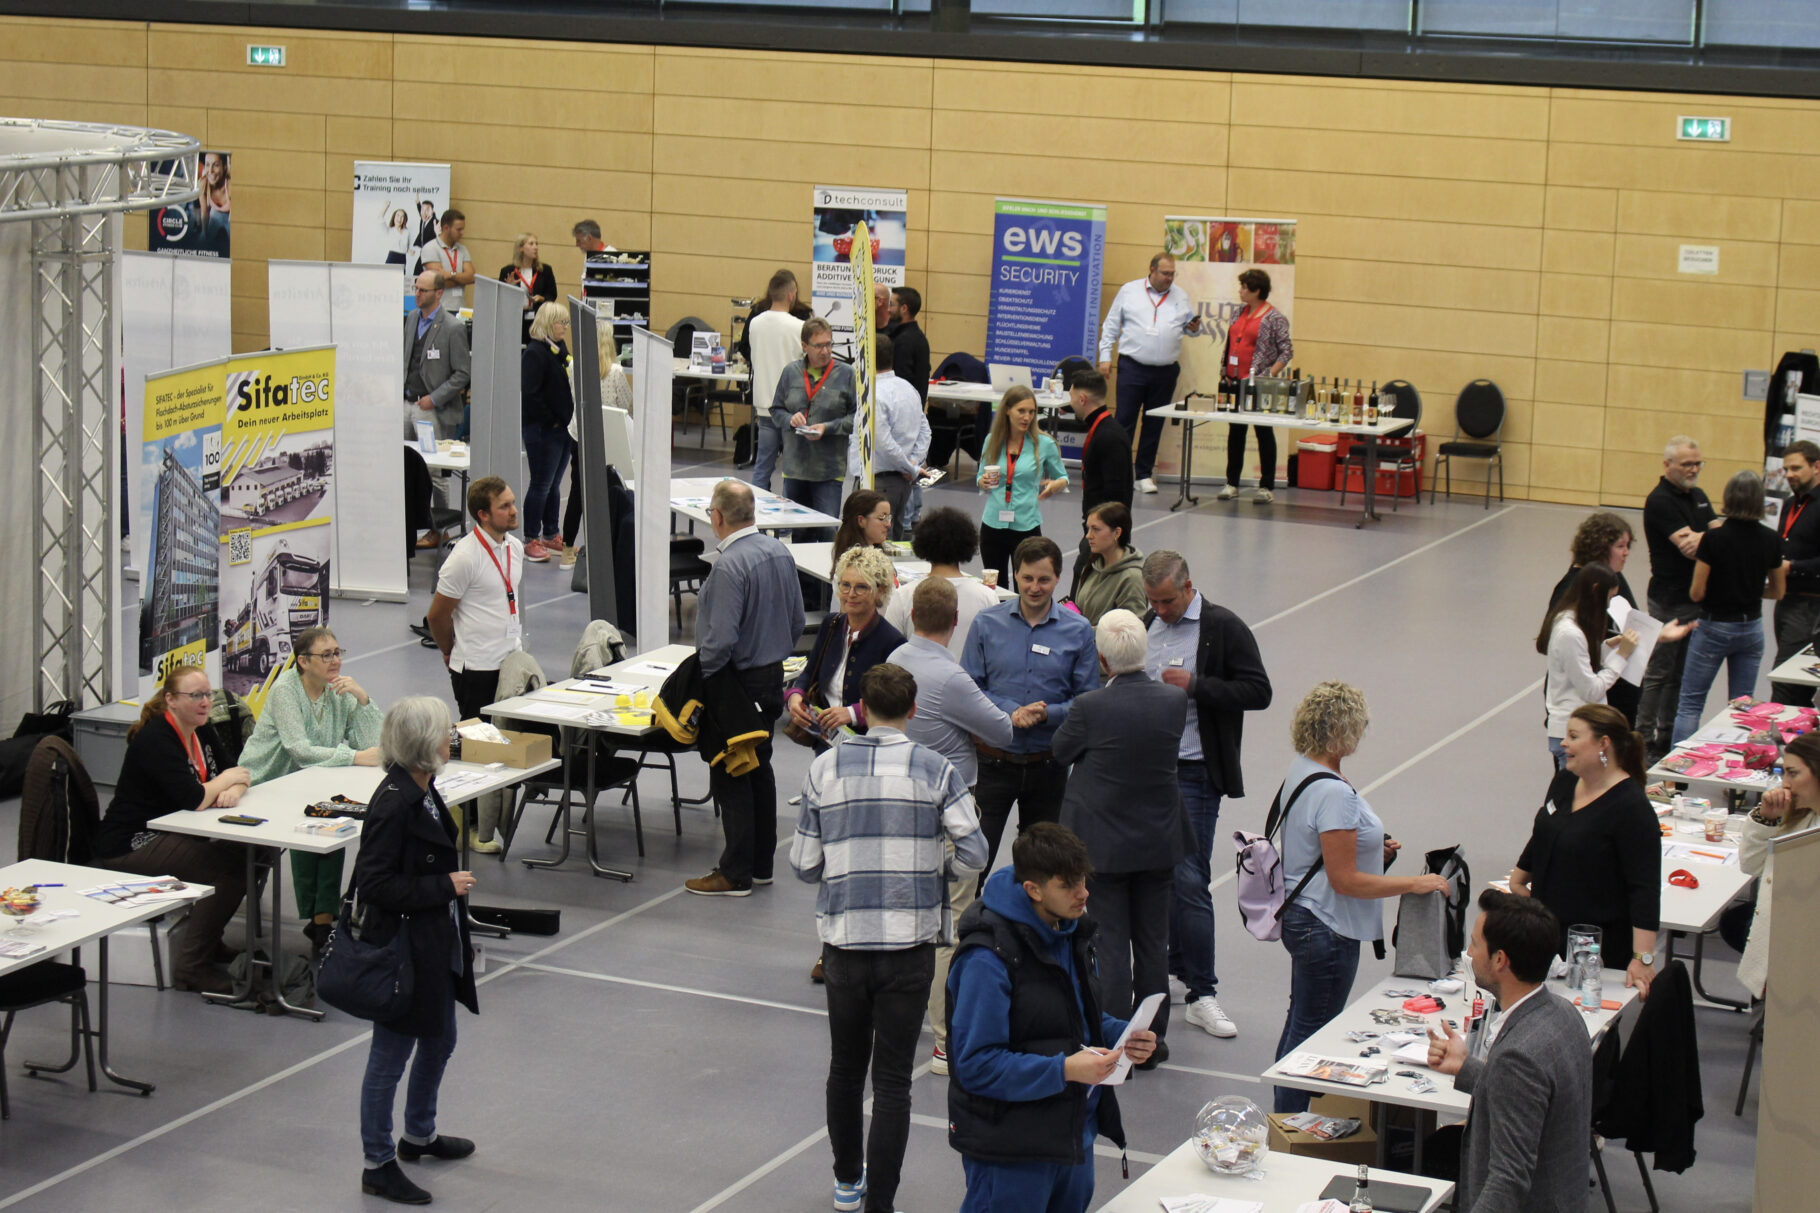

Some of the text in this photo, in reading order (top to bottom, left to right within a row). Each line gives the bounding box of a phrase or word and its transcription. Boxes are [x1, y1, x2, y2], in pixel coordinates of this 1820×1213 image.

[363, 184, 391, 193] Training
[412, 186, 440, 194] selbst?
[835, 195, 904, 207] techconsult
[1003, 227, 1082, 256] ews
[817, 264, 852, 274] BERATUN
[817, 273, 852, 281] ADDITIVE
[1000, 265, 1080, 286] SECURITY
[1089, 234, 1102, 309] INNOVATION
[999, 296, 1033, 304] OBJEKTSCHUTZ
[1086, 312, 1097, 352] TRIFFT
[156, 392, 173, 405] SIFATEC
[177, 389, 185, 399] der
[186, 385, 206, 398] Spezialist
[237, 374, 329, 411] Sifatec
[155, 421, 163, 430] bis
[179, 414, 189, 424] über
[190, 409, 204, 421] Grund
[238, 409, 329, 428] Dein neuer Arbeitsplatz
[205, 452, 220, 466] 100
